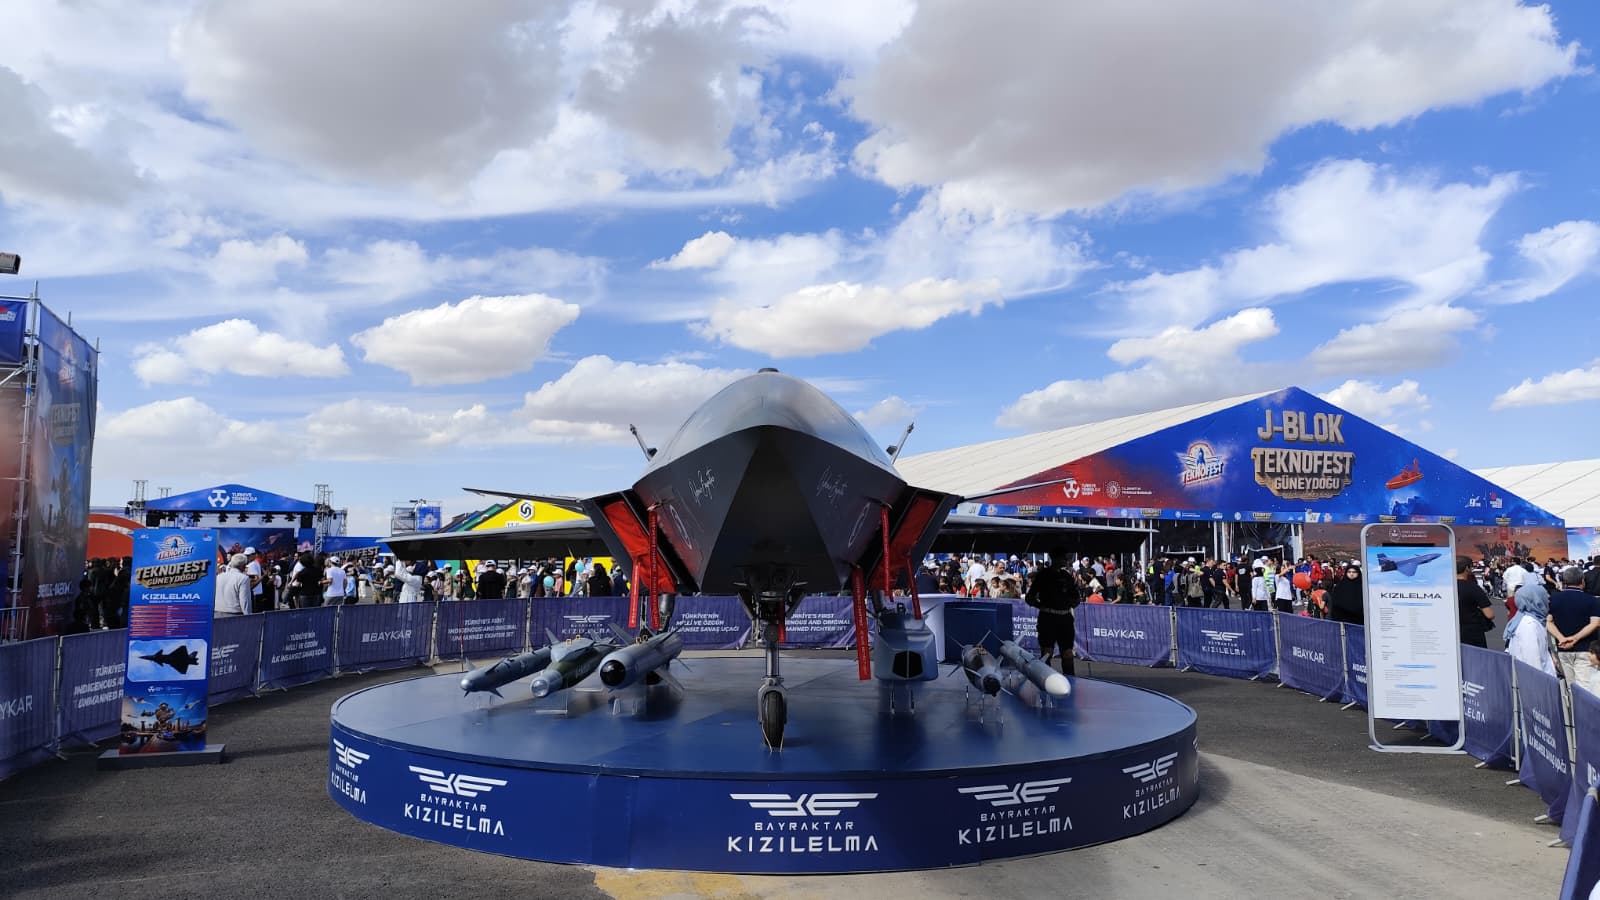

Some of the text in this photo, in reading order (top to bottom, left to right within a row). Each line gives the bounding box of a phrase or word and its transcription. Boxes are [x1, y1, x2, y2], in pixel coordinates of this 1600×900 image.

[1257, 409, 1345, 444] J-BLOK
[1251, 447, 1355, 475] TEKNOFEST
[1182, 461, 1224, 484] TEKNOFEST
[1275, 475, 1340, 490] GÜNEYDOĞU
[135, 559, 209, 579] TEKNOFEST
[370, 629, 413, 643] BAYKAR
[1100, 628, 1145, 640] BAYKAR
[1201, 645, 1247, 656] KIZILELMA
[1297, 647, 1325, 665] BAYKAR
[331, 771, 367, 805] KIZILELMA
[420, 793, 487, 812] BAYRAKTAR
[1123, 785, 1180, 820] KIZILELMA
[404, 803, 505, 836] KIZILELMA
[980, 805, 1056, 822] BAYRAKTAR
[754, 821, 854, 831] BAYRAKTAR
[958, 816, 1073, 845] KIZILELMA
[728, 835, 879, 853] KIZILELMA
